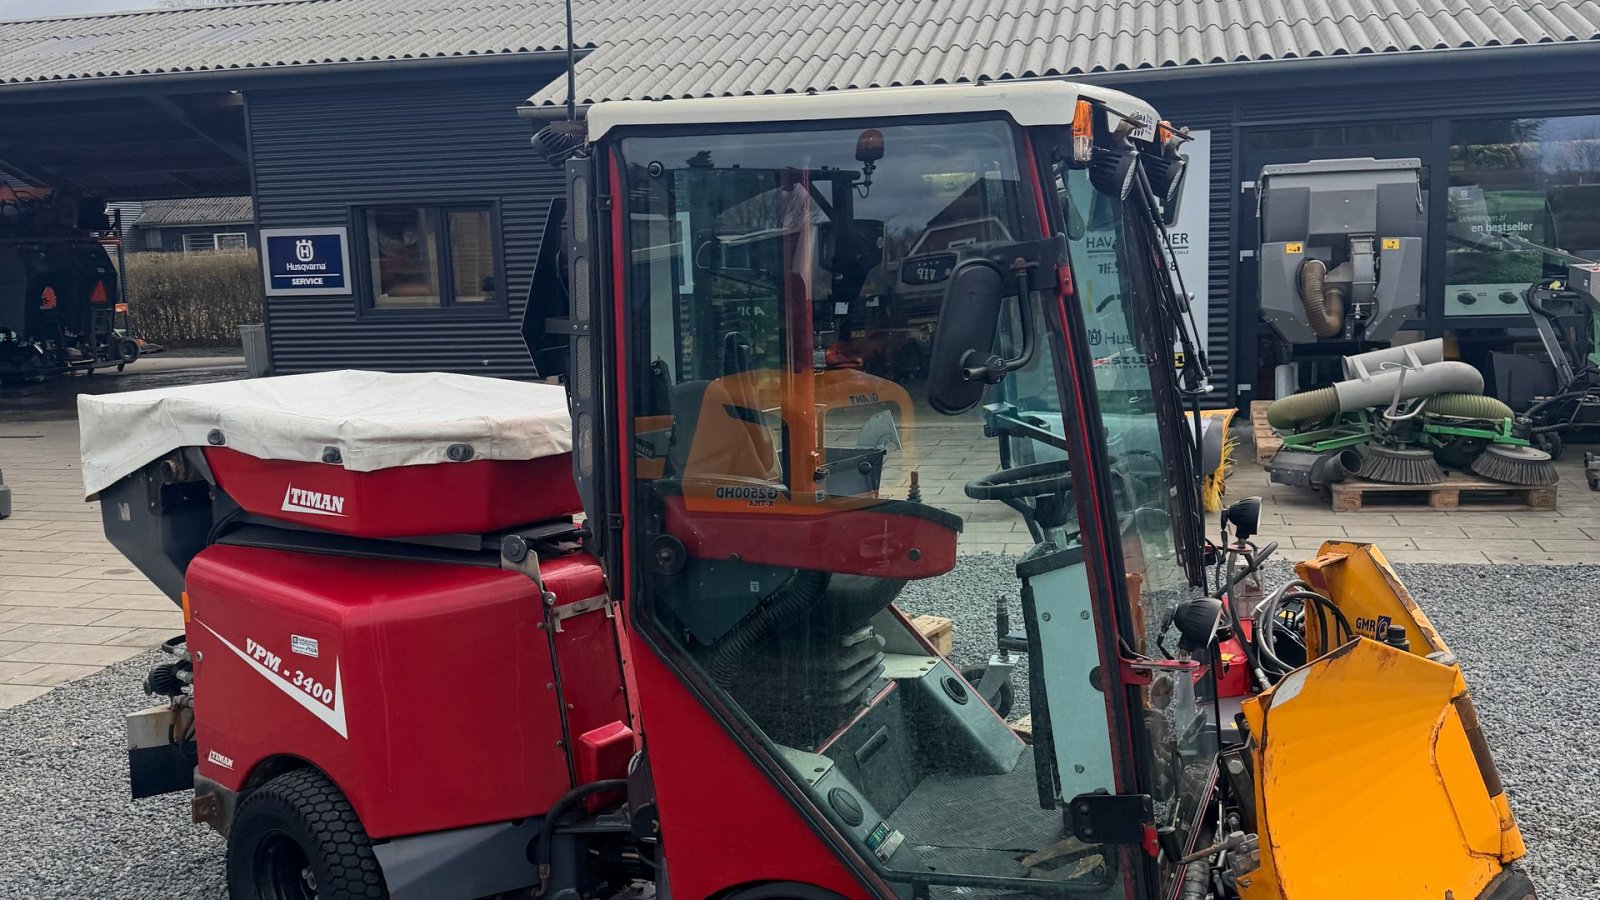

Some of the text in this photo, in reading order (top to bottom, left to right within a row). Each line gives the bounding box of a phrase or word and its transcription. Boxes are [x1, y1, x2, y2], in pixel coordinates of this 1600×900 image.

[1486, 221, 1533, 232] bestseller
[286, 262, 327, 272] Husqvarna
[291, 277, 324, 286] SERVICE
[290, 487, 345, 513] TIMAN
[1355, 617, 1376, 632] GMR
[245, 637, 282, 674] VPM
[292, 670, 333, 704] 3400
[210, 751, 233, 767] TIMAN
